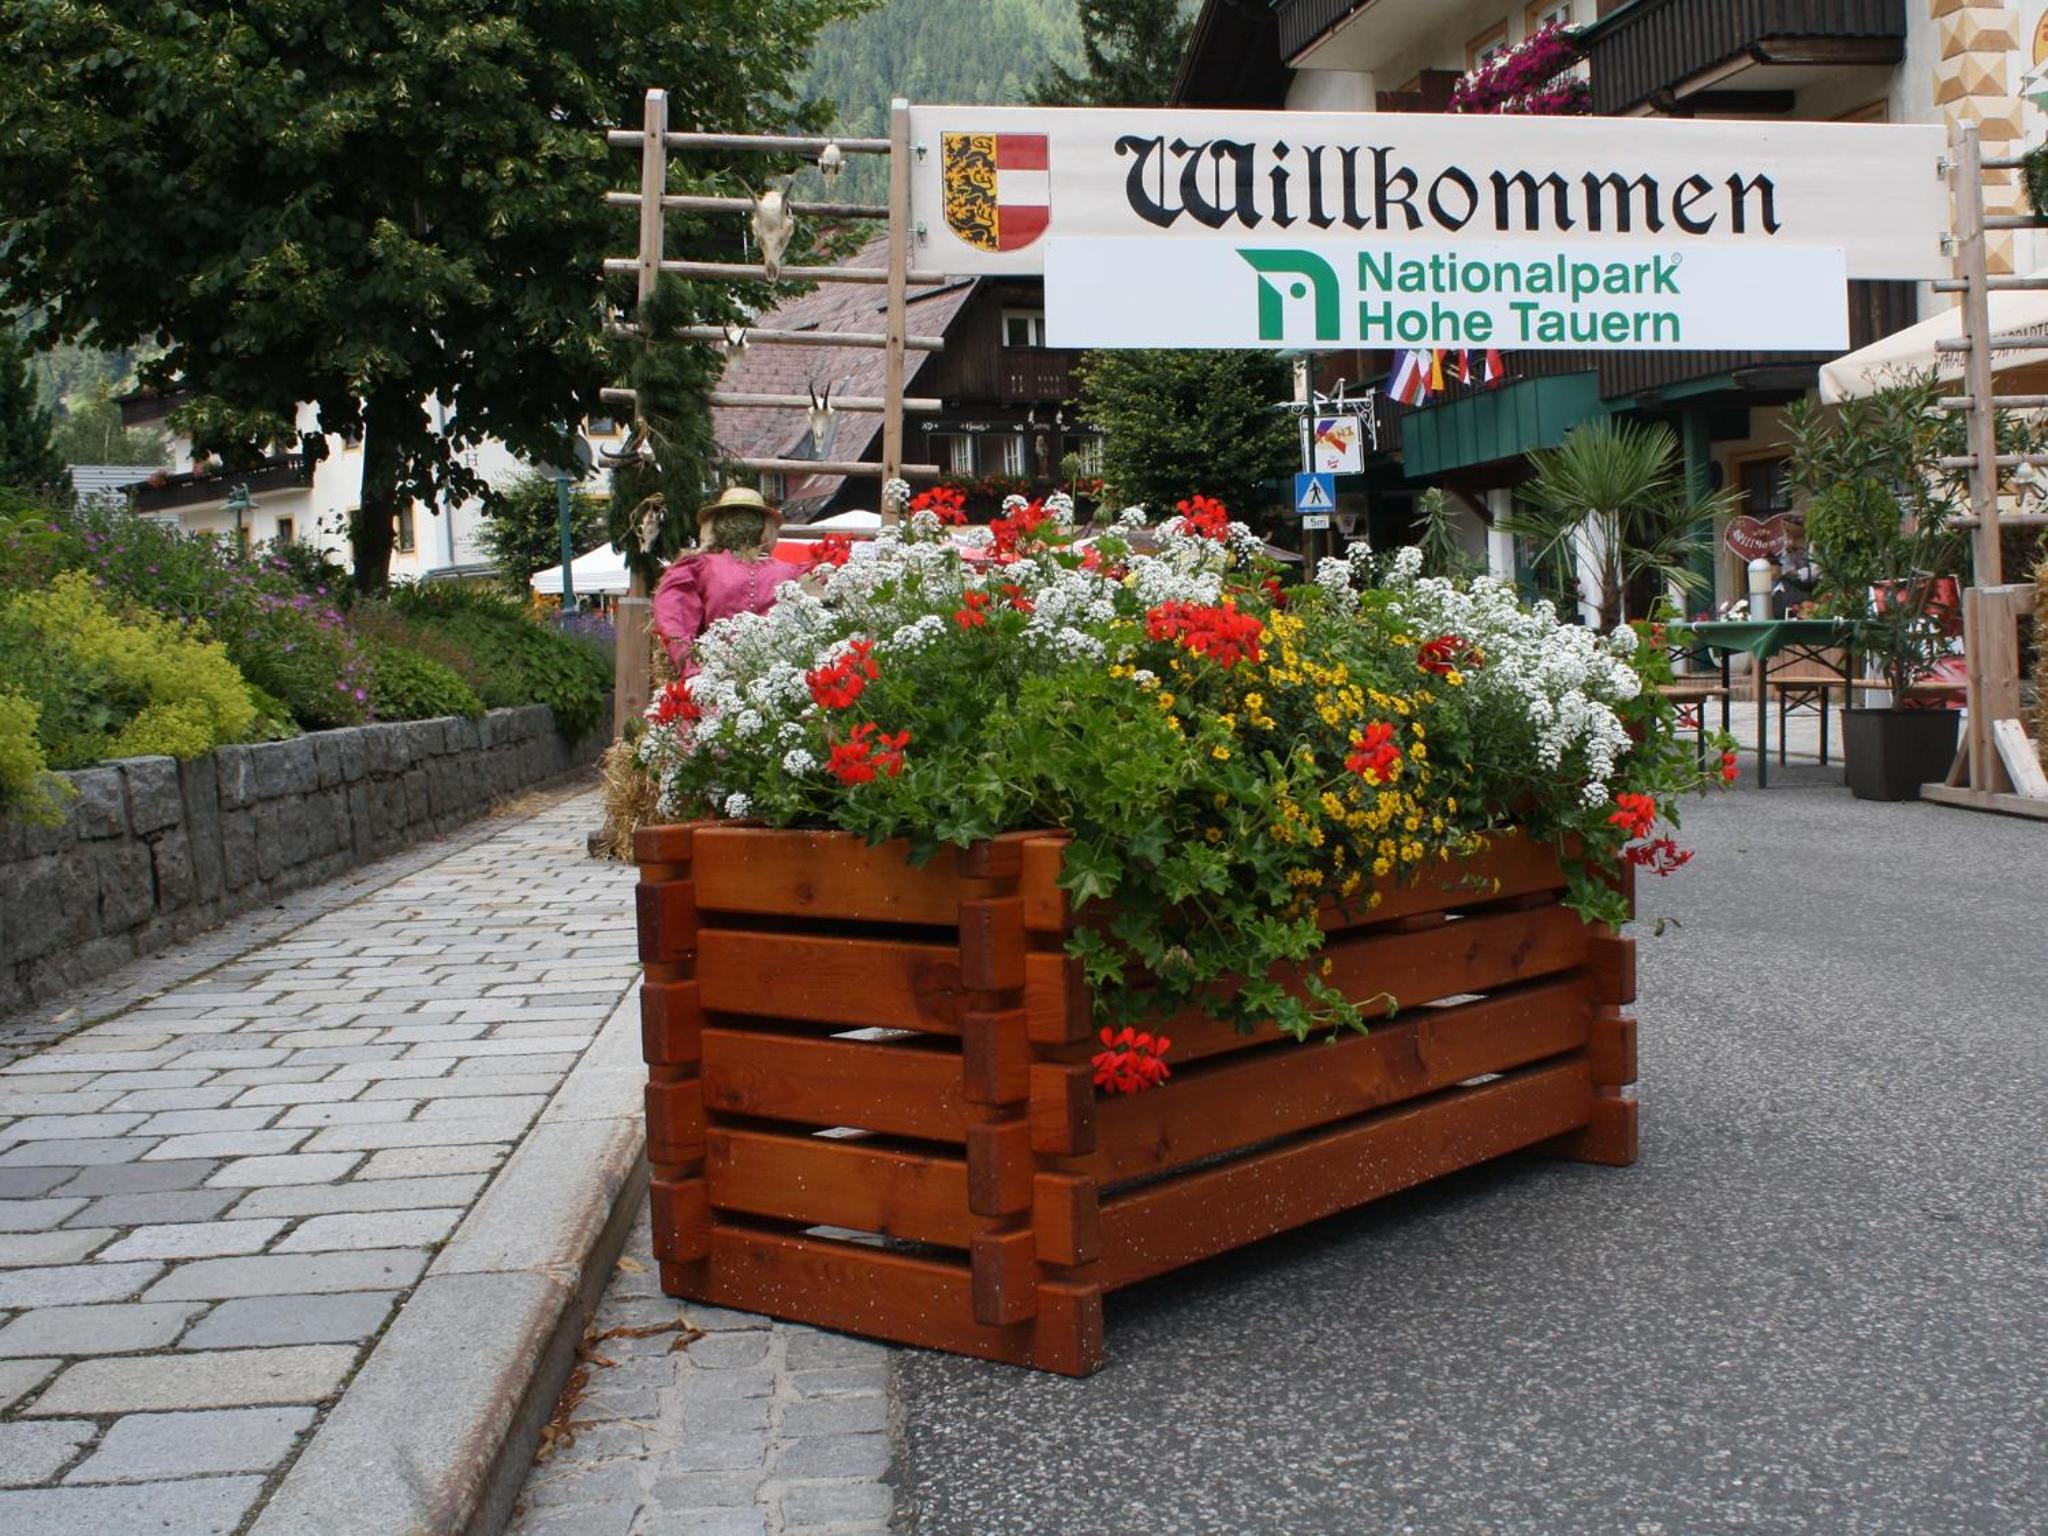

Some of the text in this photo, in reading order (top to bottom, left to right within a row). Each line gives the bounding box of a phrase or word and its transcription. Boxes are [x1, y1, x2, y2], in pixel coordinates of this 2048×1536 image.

[1113, 136, 1781, 236] Willkommen
[1359, 301, 1680, 342] Hohe Tauern
